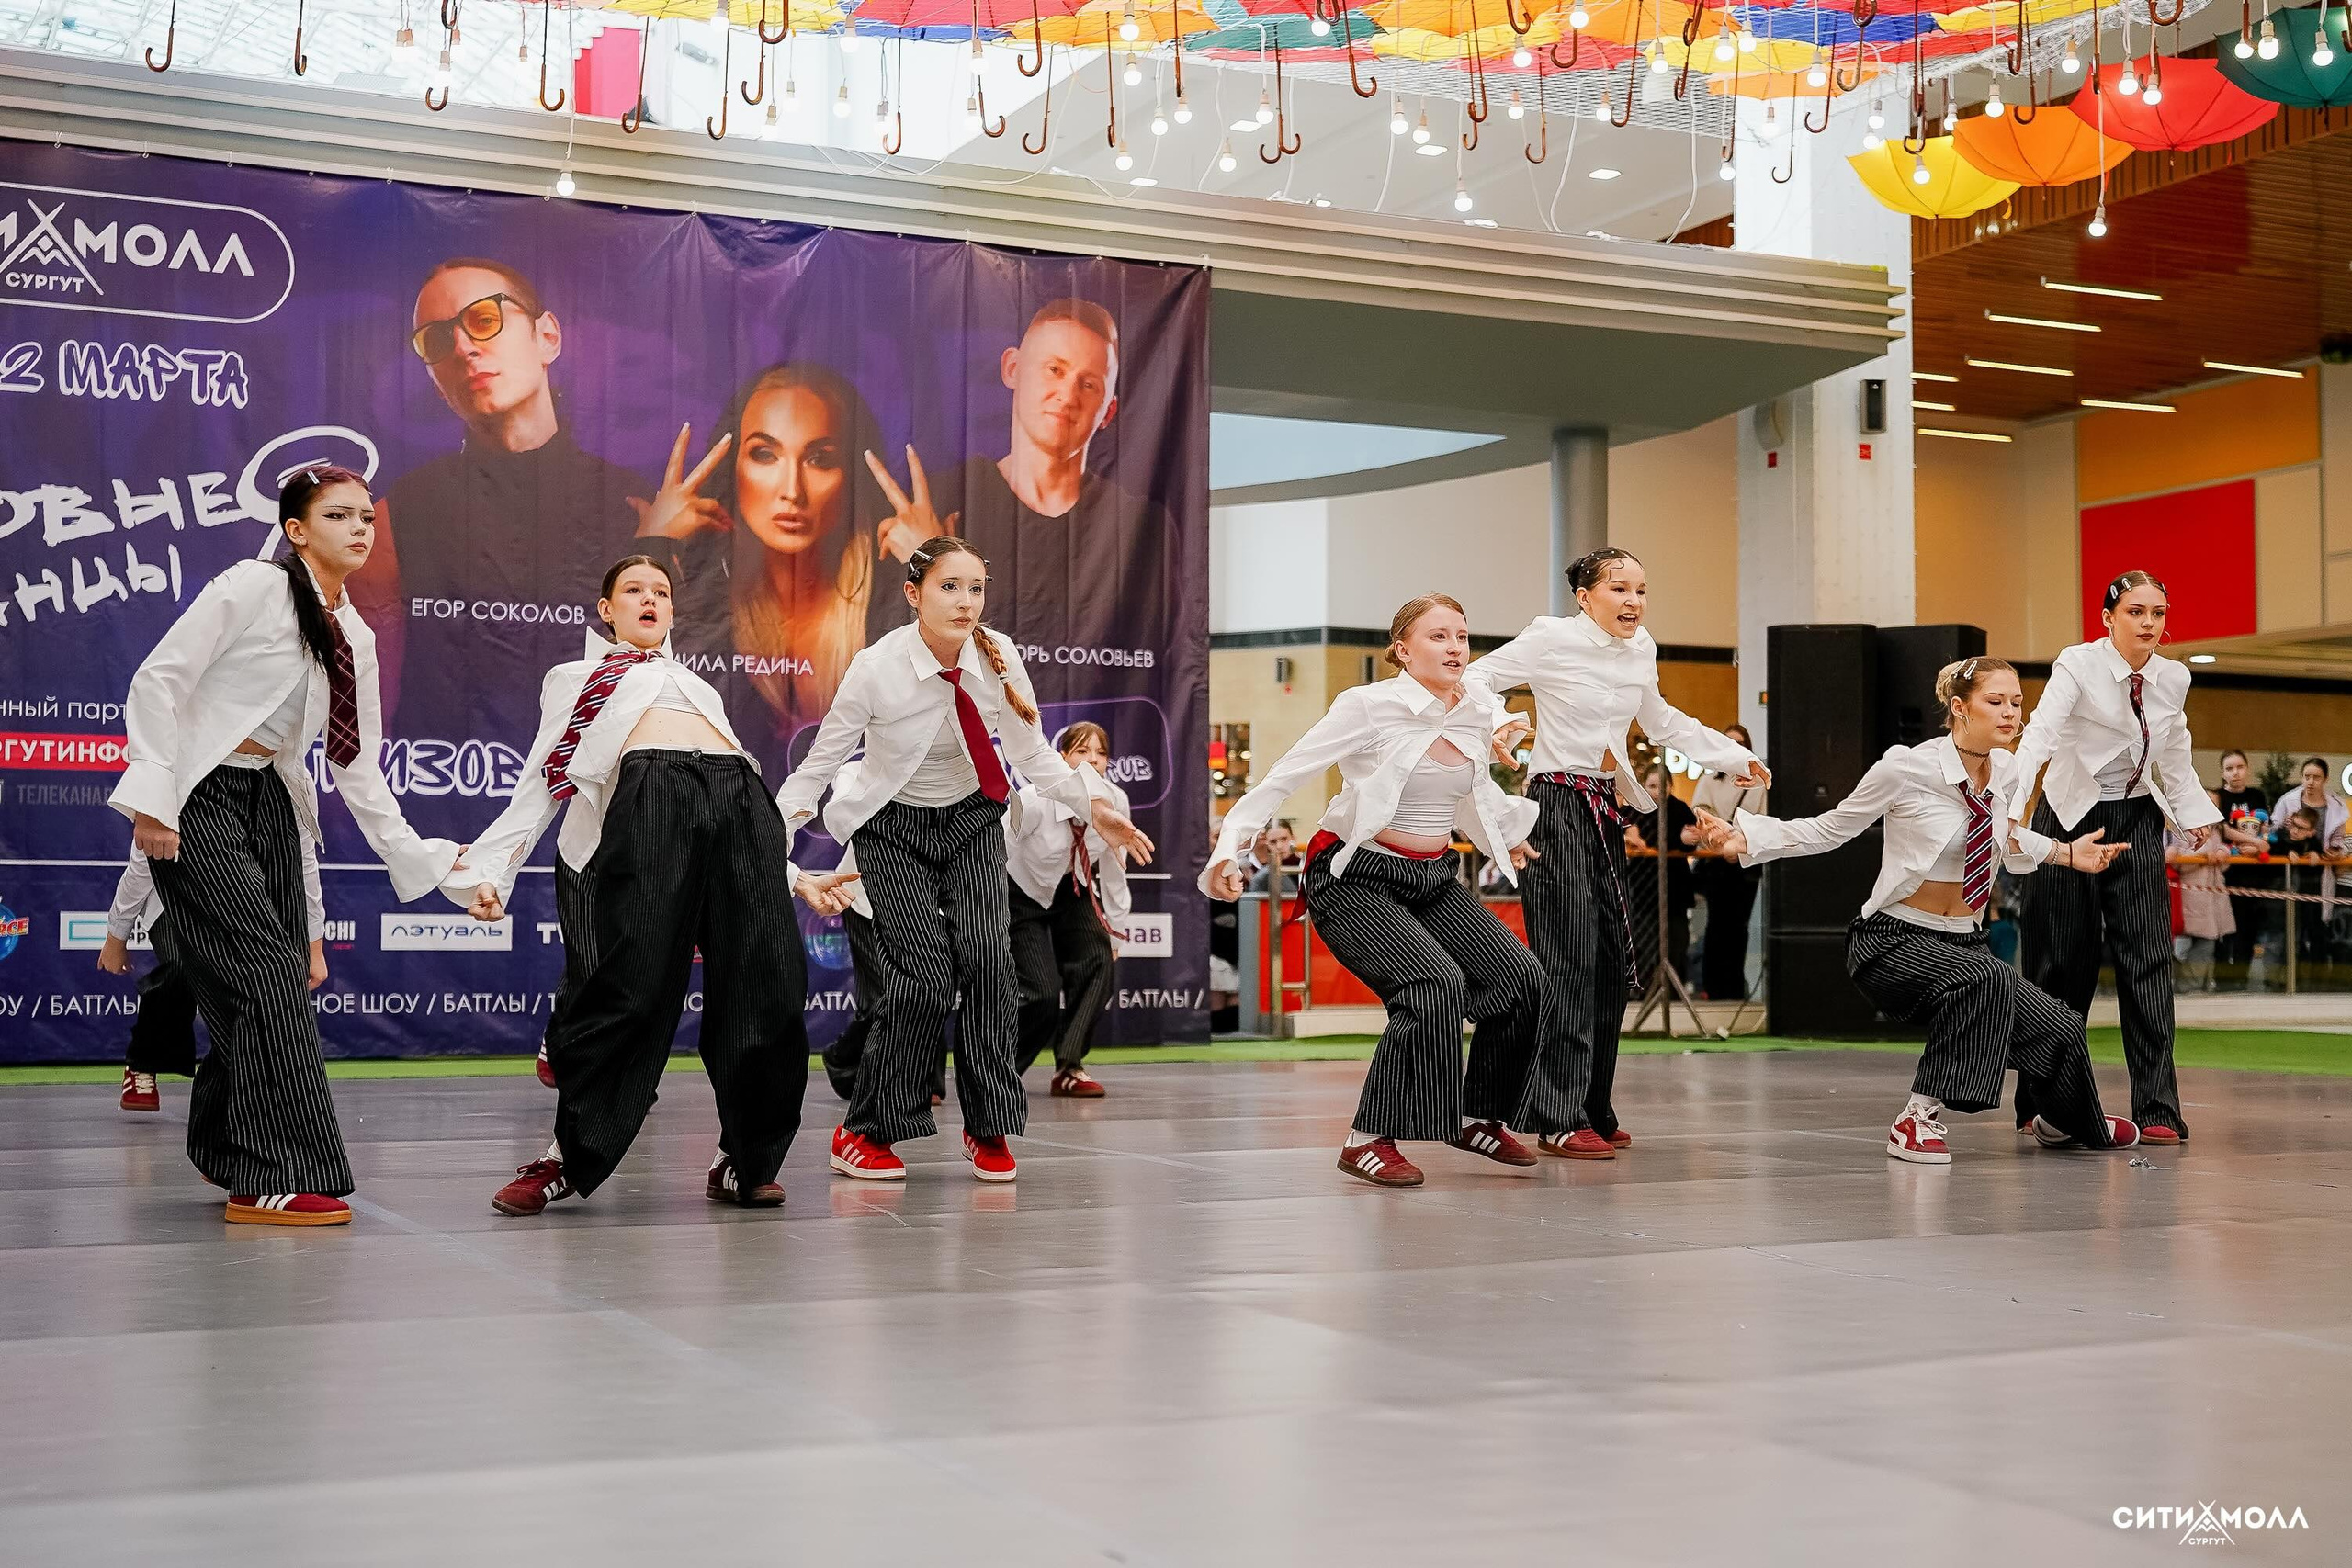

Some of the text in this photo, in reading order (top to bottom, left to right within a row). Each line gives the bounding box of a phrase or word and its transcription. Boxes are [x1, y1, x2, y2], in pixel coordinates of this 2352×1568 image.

[6, 272, 85, 293] СУРГУТ
[59, 339, 249, 410] МАРТА
[0, 542, 182, 627] НЦЫ
[412, 597, 586, 625] ЕГОР СОКОЛОВ
[732, 653, 815, 677] РЕДИНА
[1054, 645, 1155, 668] СОЛОВЬЕВ
[0, 739, 130, 764] ГУТИНФ
[51, 994, 141, 1016] БАТТЛЫ
[361, 992, 421, 1014] ШОУ
[443, 993, 526, 1013] БАТТЛЫ
[1118, 988, 1191, 1009] БАТТЛЫ
